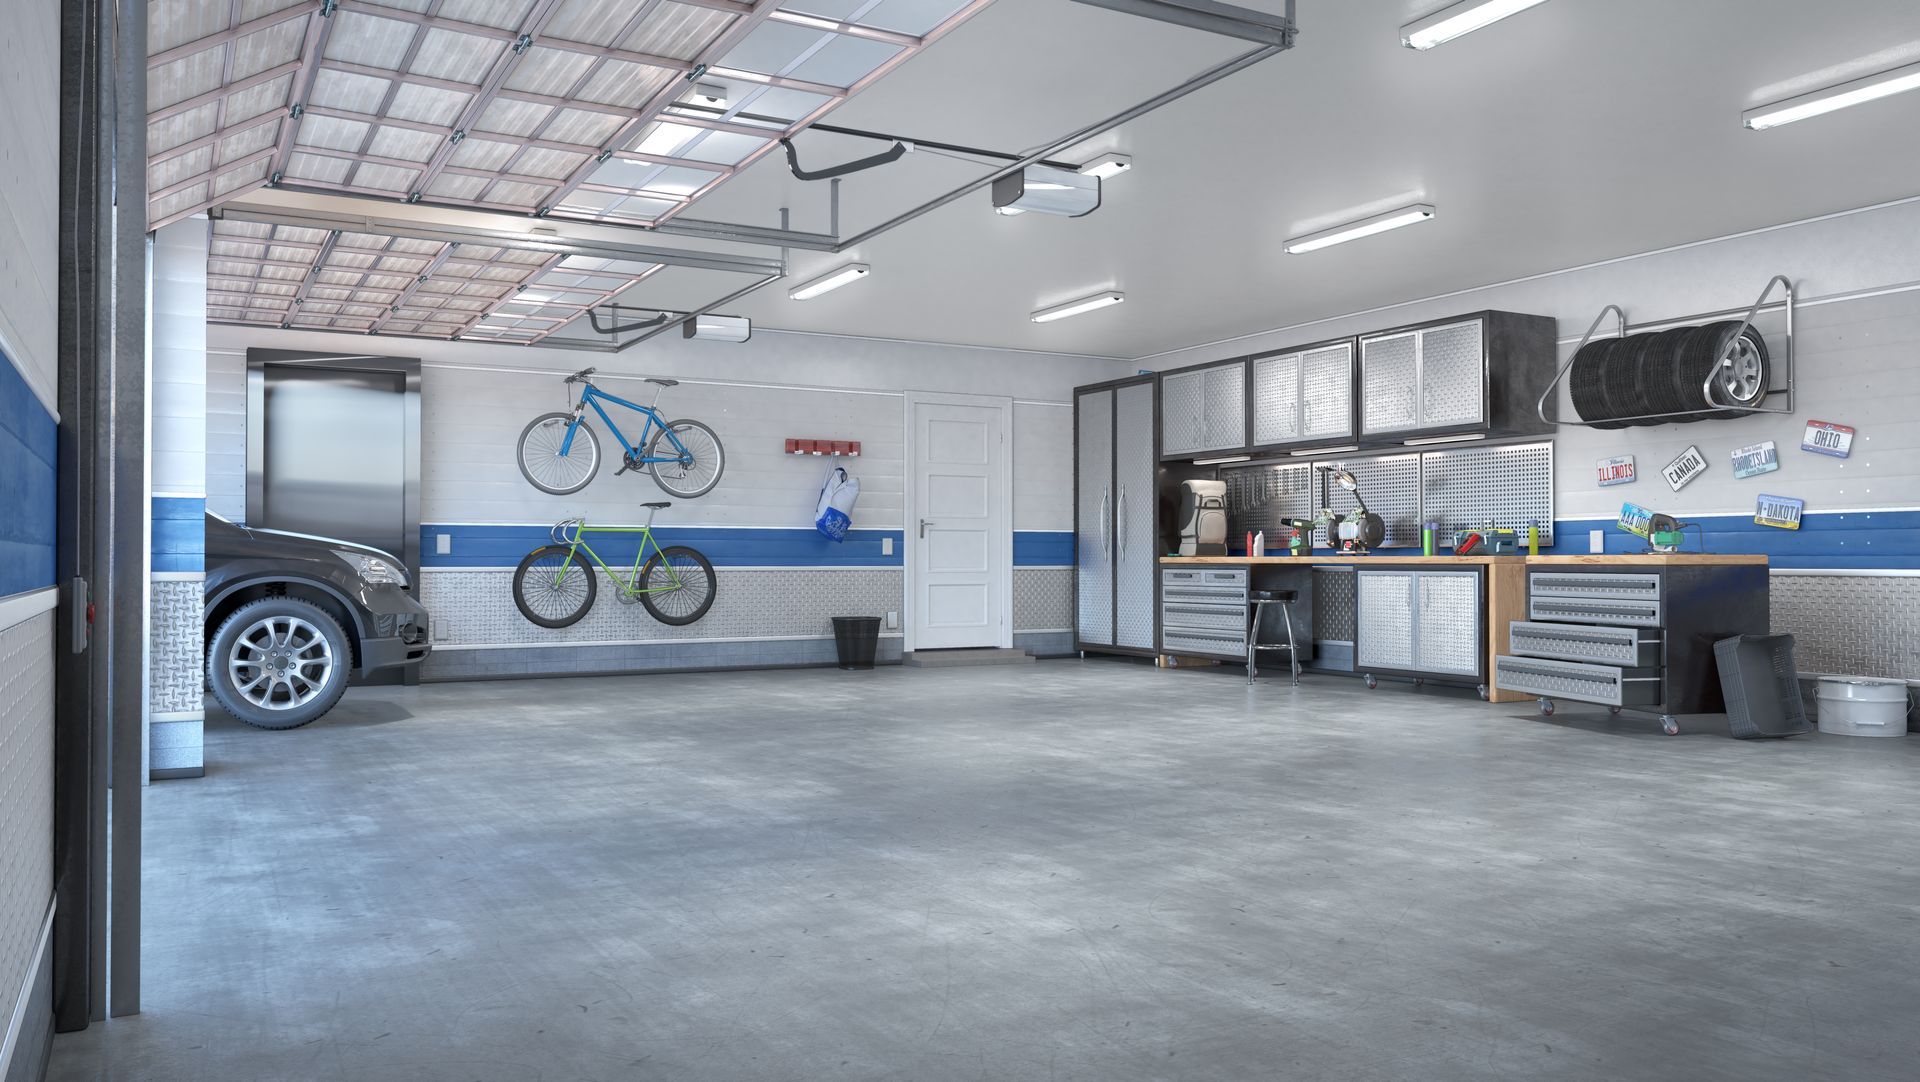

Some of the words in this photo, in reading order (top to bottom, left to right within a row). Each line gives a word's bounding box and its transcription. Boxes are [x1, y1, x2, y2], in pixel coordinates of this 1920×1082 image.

[1815, 430, 1841, 449] OHIO
[1598, 463, 1633, 481] ILLINOIS
[1669, 455, 1701, 484] CANADA
